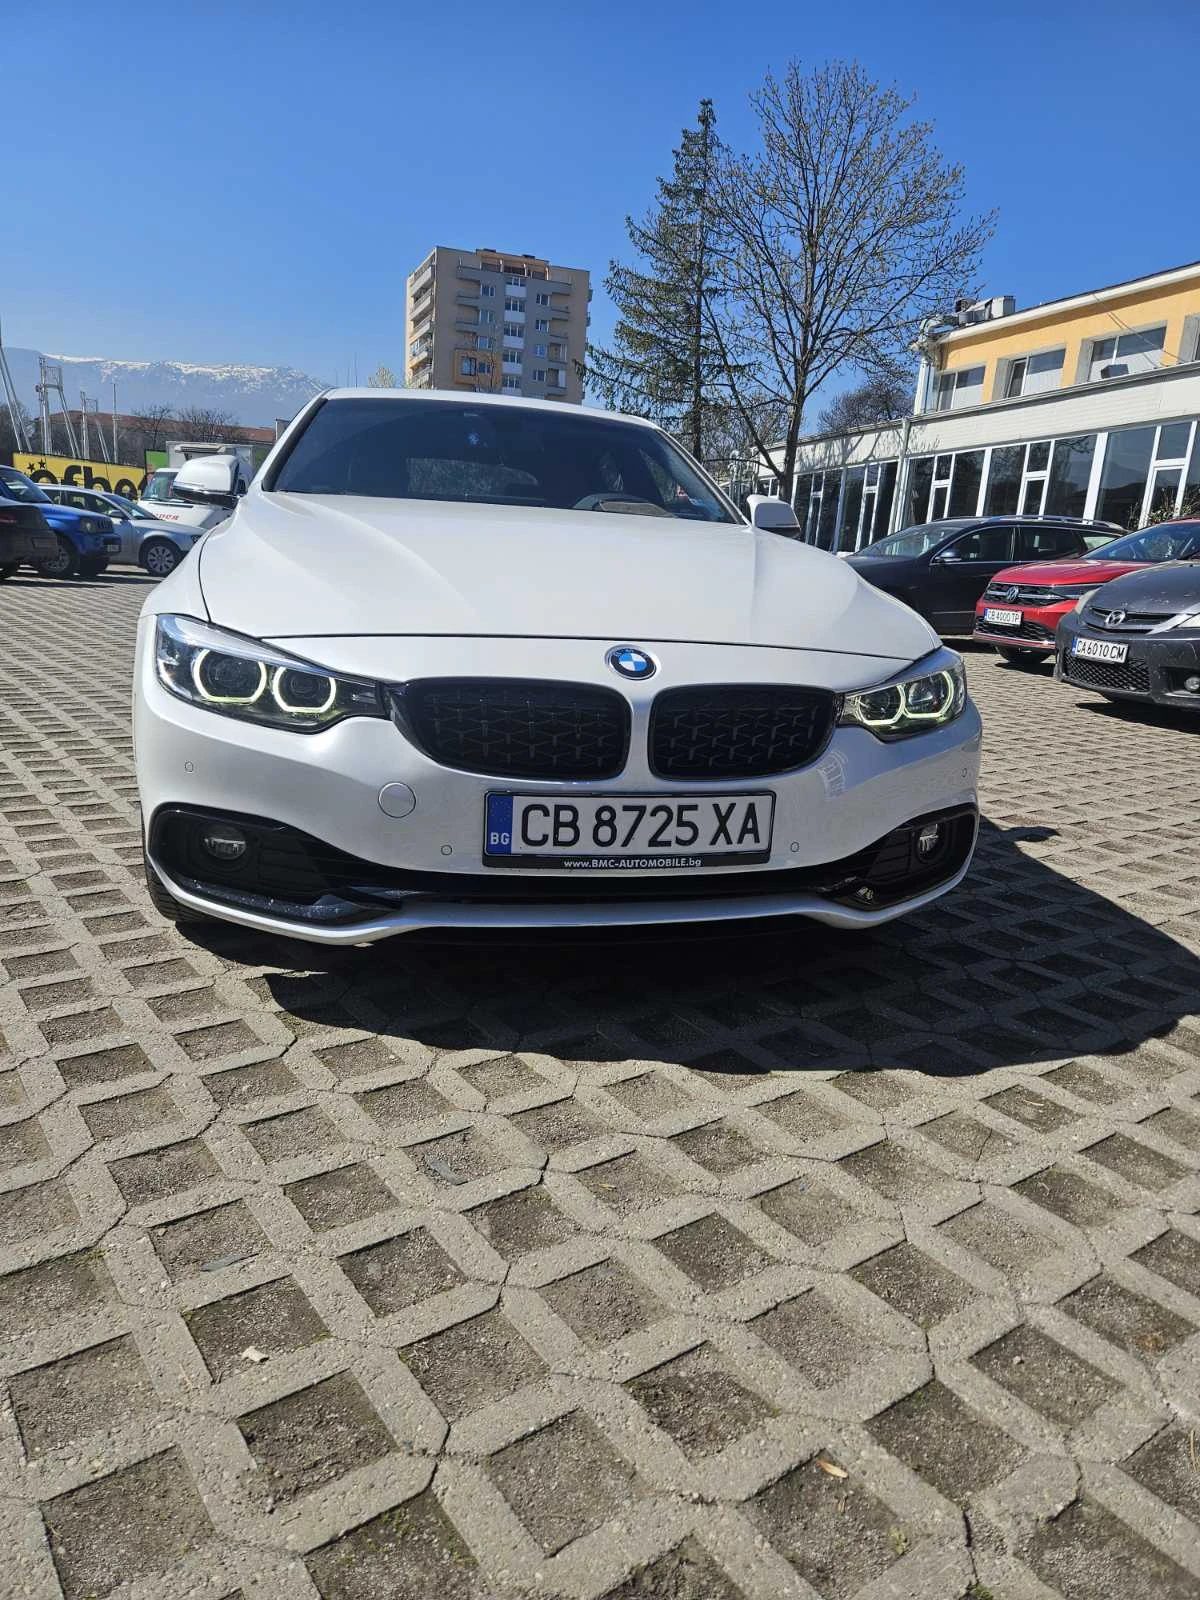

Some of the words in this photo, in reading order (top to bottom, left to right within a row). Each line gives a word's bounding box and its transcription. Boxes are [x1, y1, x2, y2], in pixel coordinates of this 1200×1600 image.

[1077, 640, 1086, 654] CA
[1087, 641, 1110, 657] 6010
[1110, 645, 1125, 660] CM
[521, 803, 581, 848] CB
[592, 804, 699, 848] 8725
[709, 802, 760, 846] XA
[490, 832, 510, 845] BG
[563, 858, 702, 869] www.BMC-AUTOMOBILE.bg
